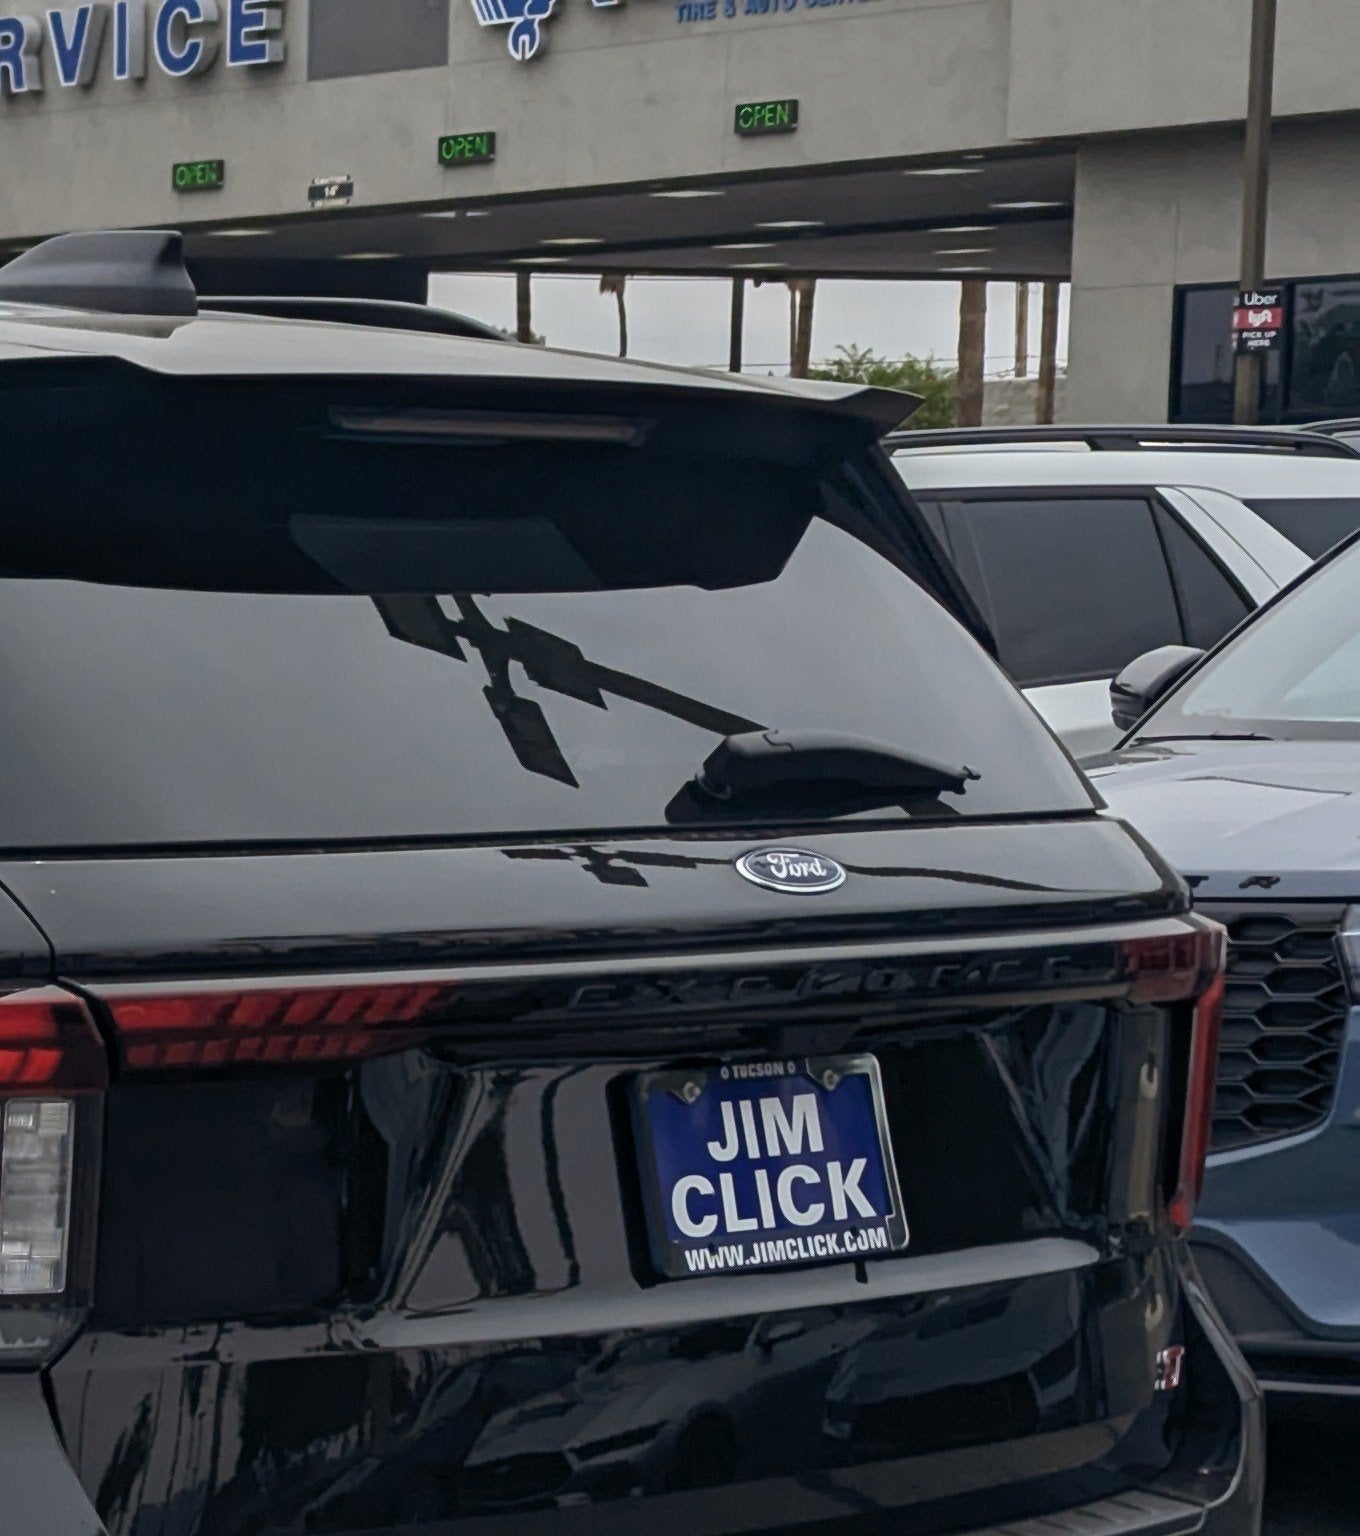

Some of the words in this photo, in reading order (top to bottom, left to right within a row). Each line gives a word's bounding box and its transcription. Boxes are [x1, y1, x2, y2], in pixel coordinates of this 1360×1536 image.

[738, 103, 791, 129] OPEN
[441, 136, 488, 160] OPEN
[1244, 291, 1278, 306] Uber
[766, 852, 828, 879] Ford
[731, 1061, 785, 1079] TUCSON
[707, 1092, 825, 1162] JIM
[671, 1157, 878, 1239] CLICK
[684, 1226, 888, 1272] WWW.JIMCLICK.COM
